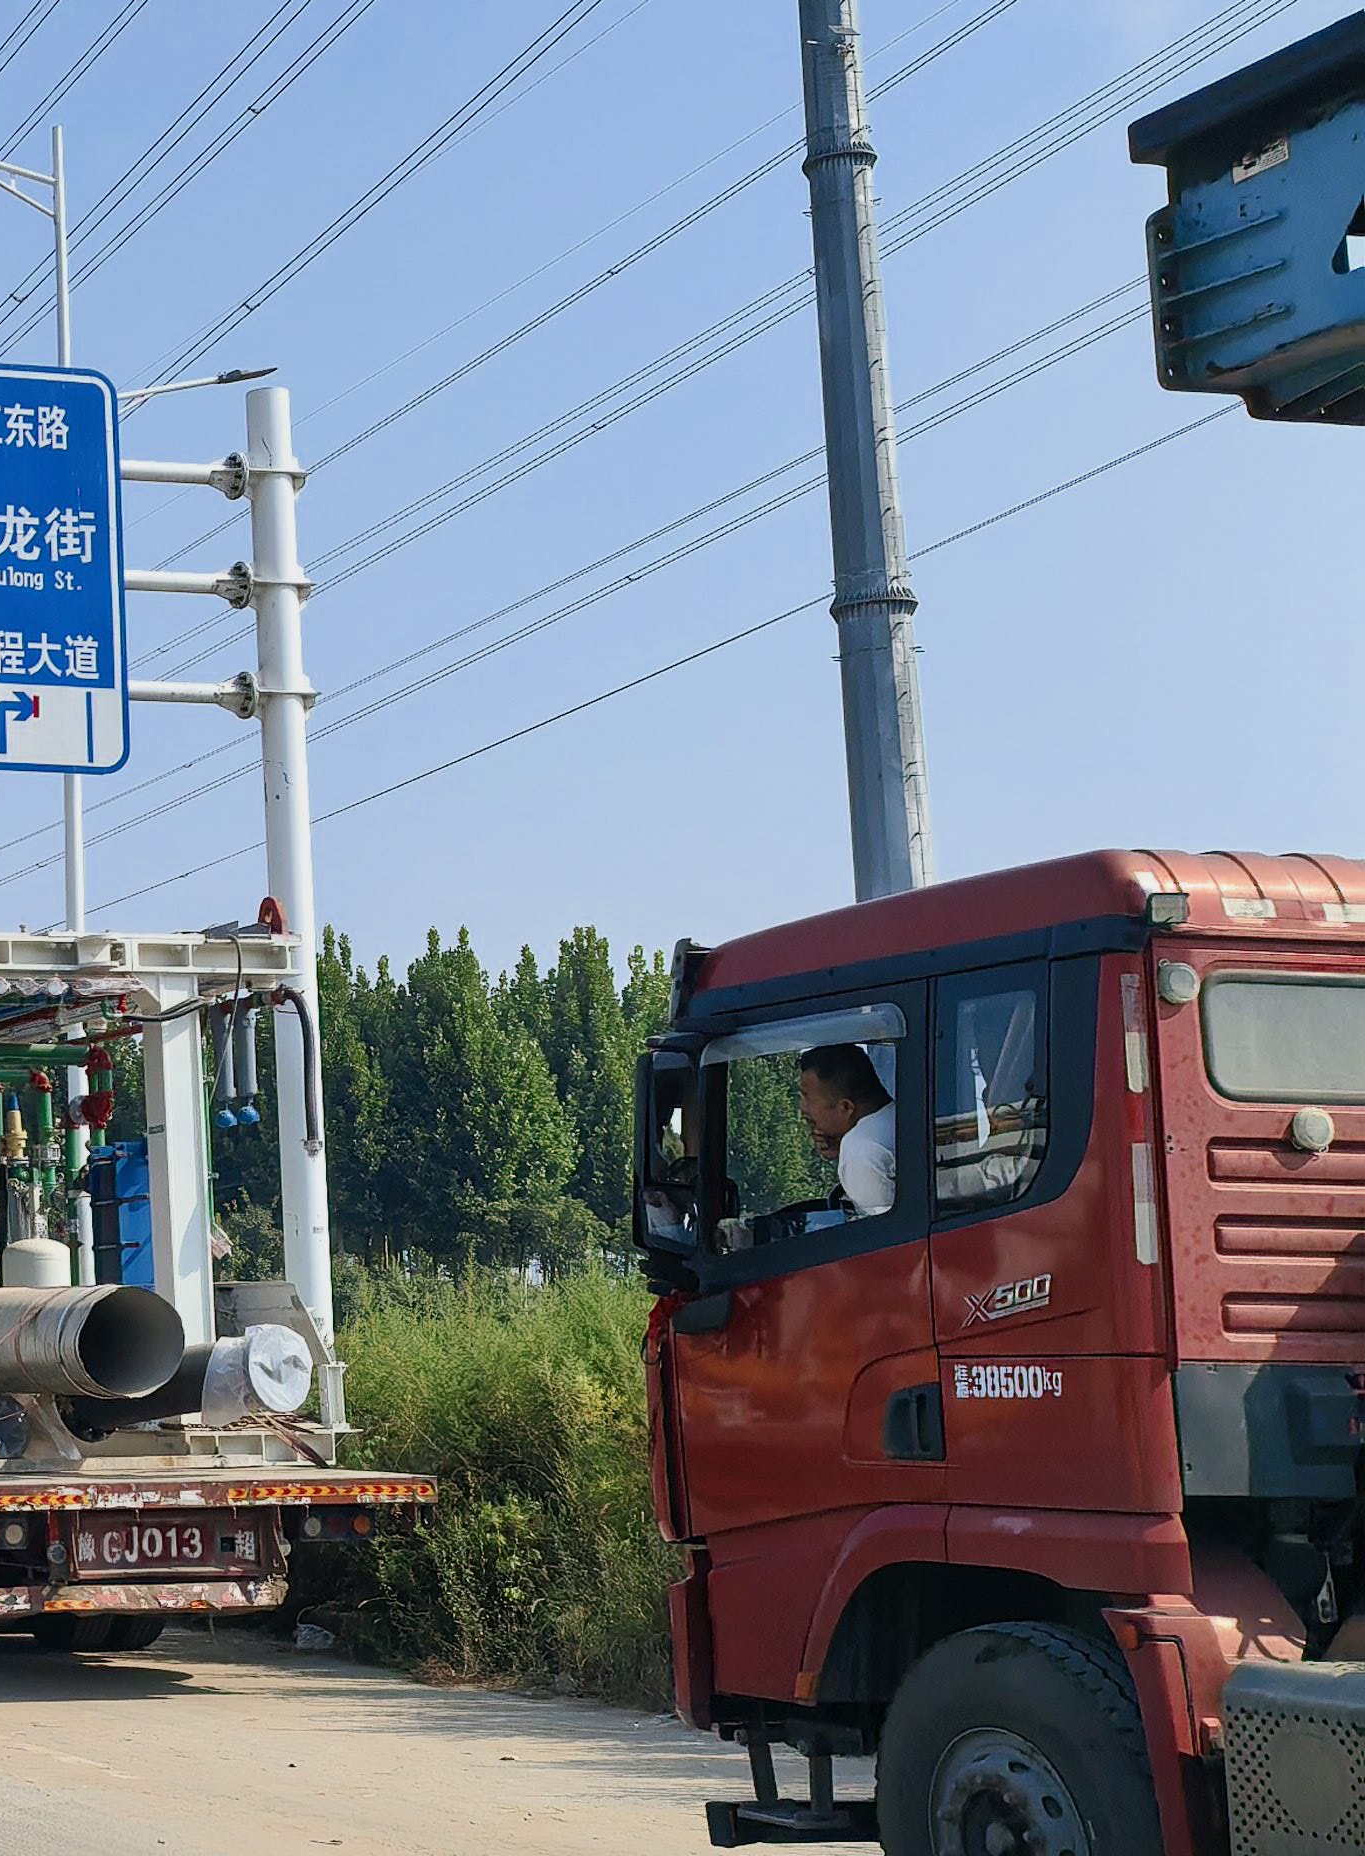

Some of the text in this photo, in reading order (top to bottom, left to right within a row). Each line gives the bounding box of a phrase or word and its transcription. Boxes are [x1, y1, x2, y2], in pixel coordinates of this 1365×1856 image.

[54, 570, 83, 591] St.
[960, 1272, 1052, 1330] X500
[234, 1529, 256, 1562] 超
